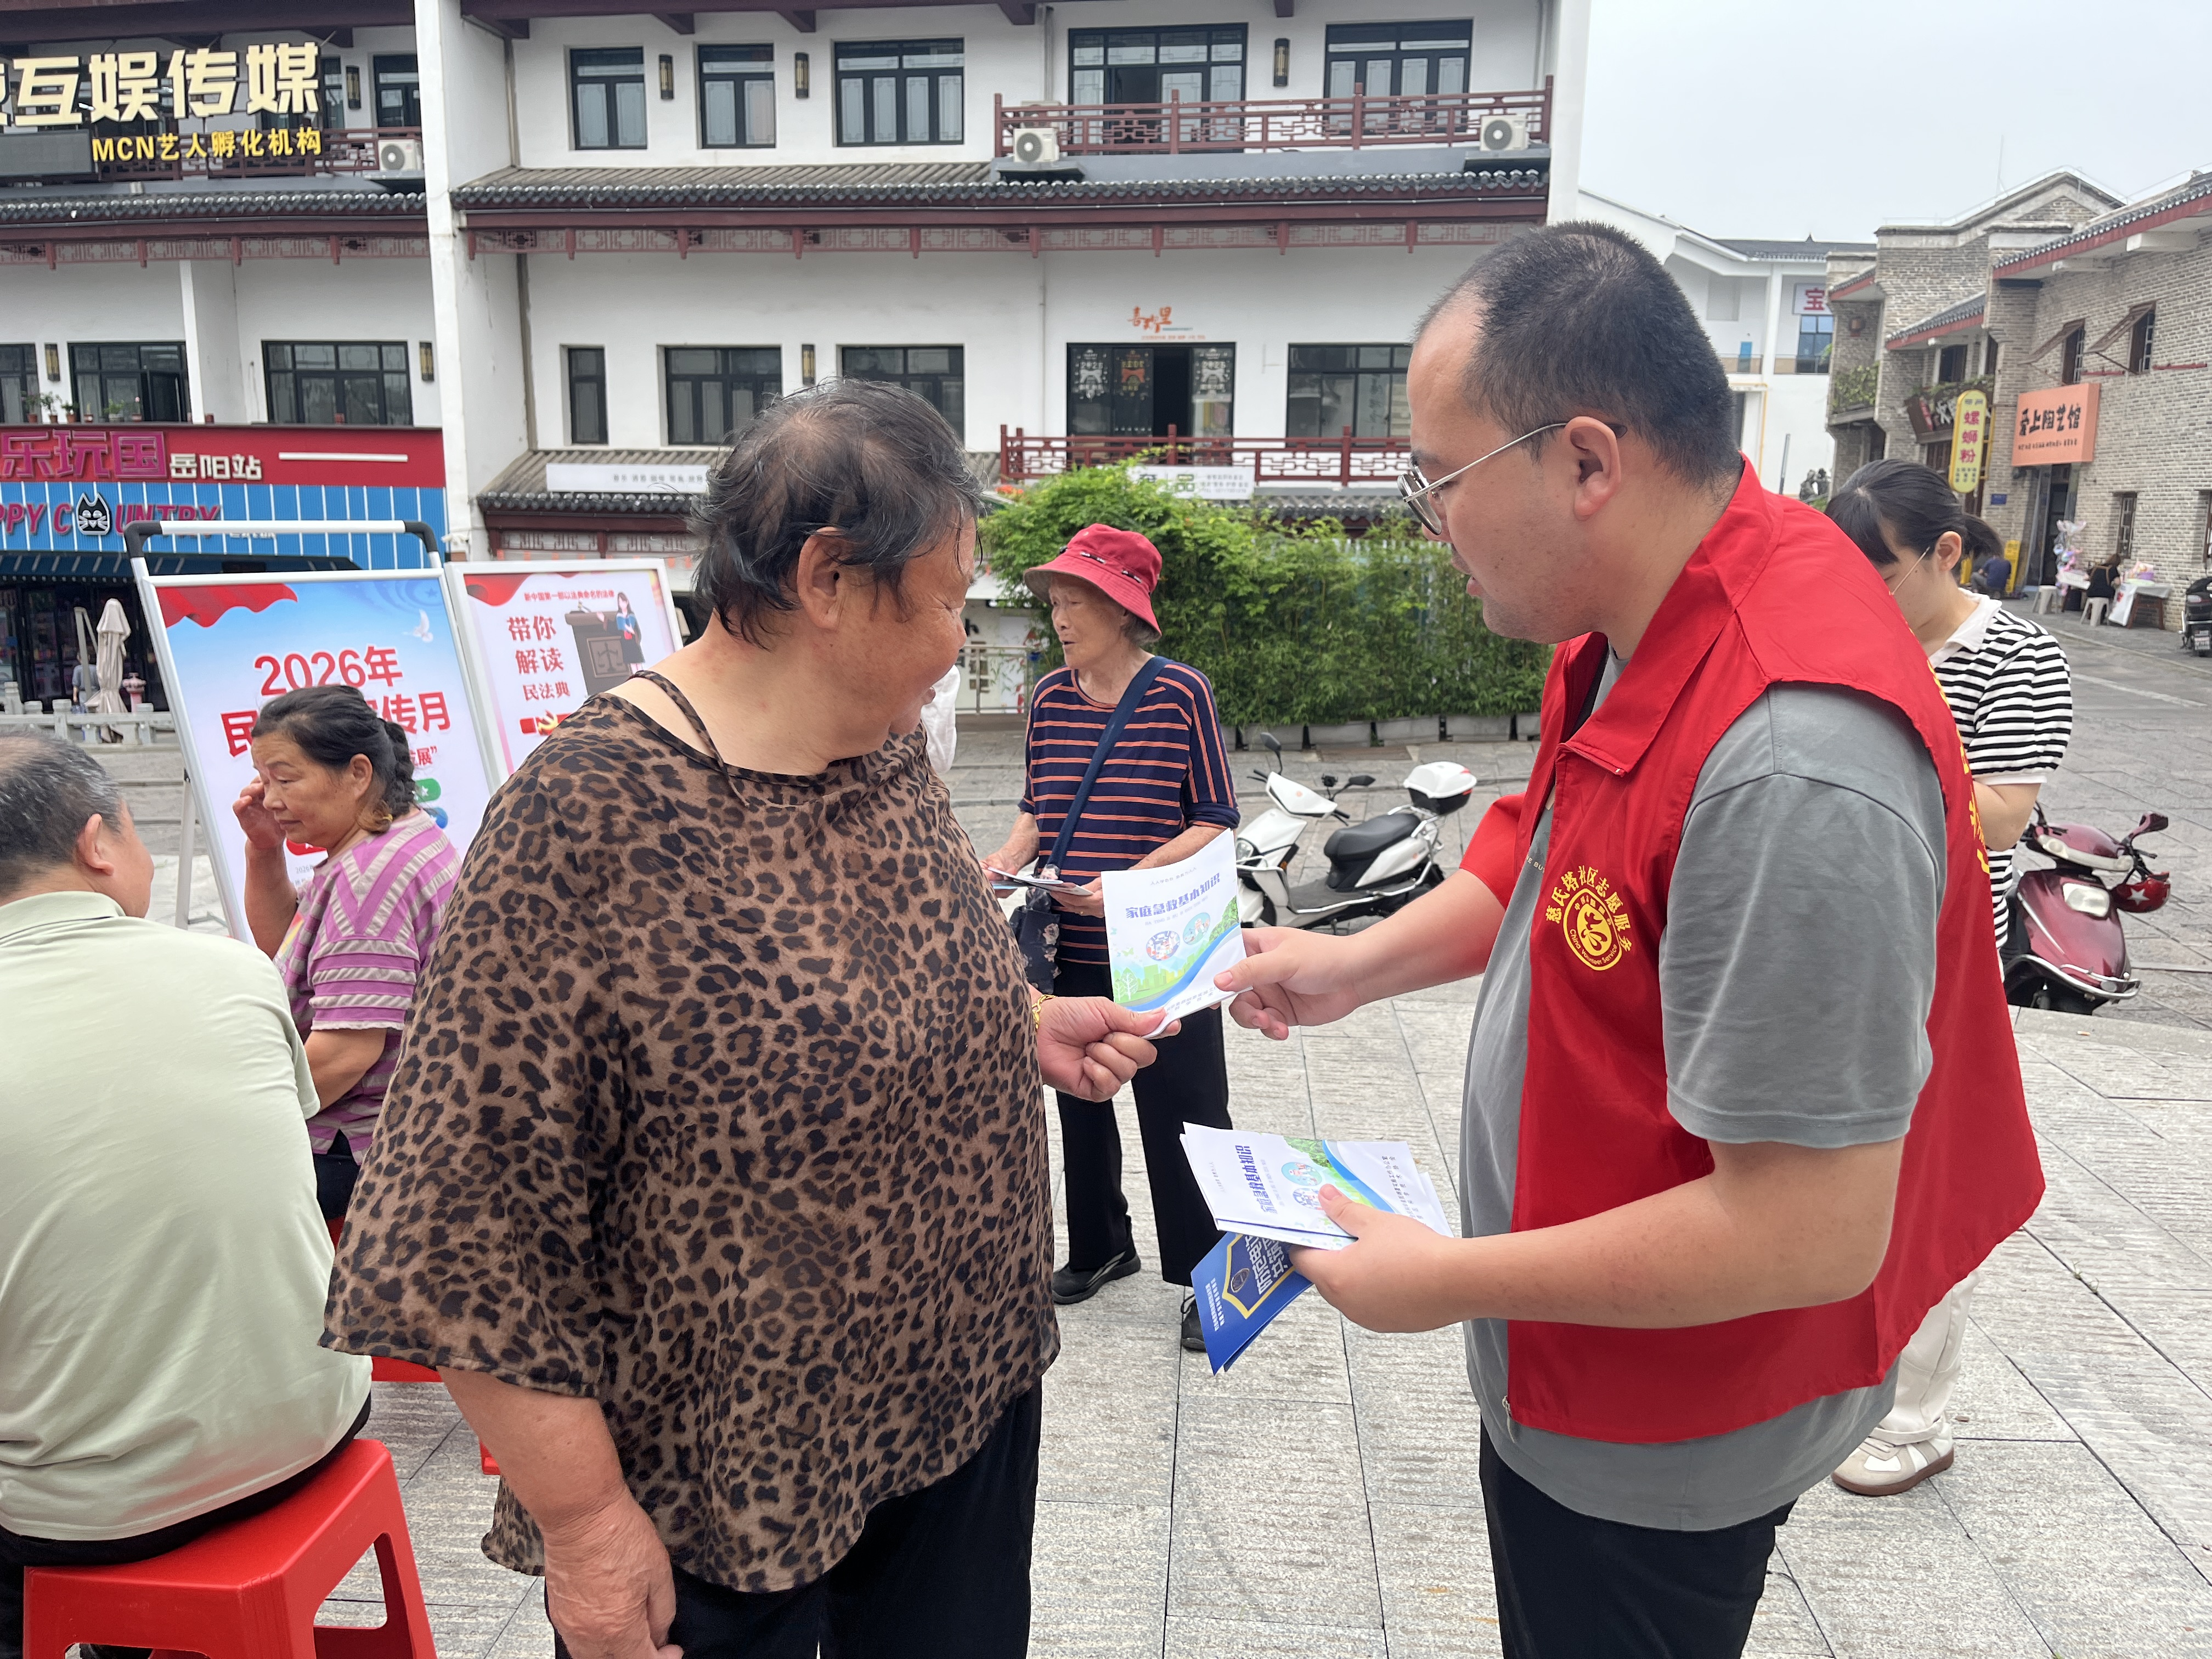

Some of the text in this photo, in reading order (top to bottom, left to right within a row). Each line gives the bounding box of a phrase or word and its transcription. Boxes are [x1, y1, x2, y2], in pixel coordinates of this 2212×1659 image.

[0, 42, 319, 126] 互娱传媒
[92, 126, 322, 163] MCN艺人孵化机构
[1803, 287, 1825, 311] 宝
[2019, 403, 2081, 436] 爱上陶艺馆
[170, 453, 262, 480] 岳阳站
[506, 614, 556, 642] 带你
[253, 645, 404, 696] 2026年
[515, 646, 565, 675] 解读
[523, 681, 571, 701] 民法典
[1126, 872, 1220, 919] 家庭急救基本知识
[1234, 1145, 1278, 1214] 家庭急救基本知识
